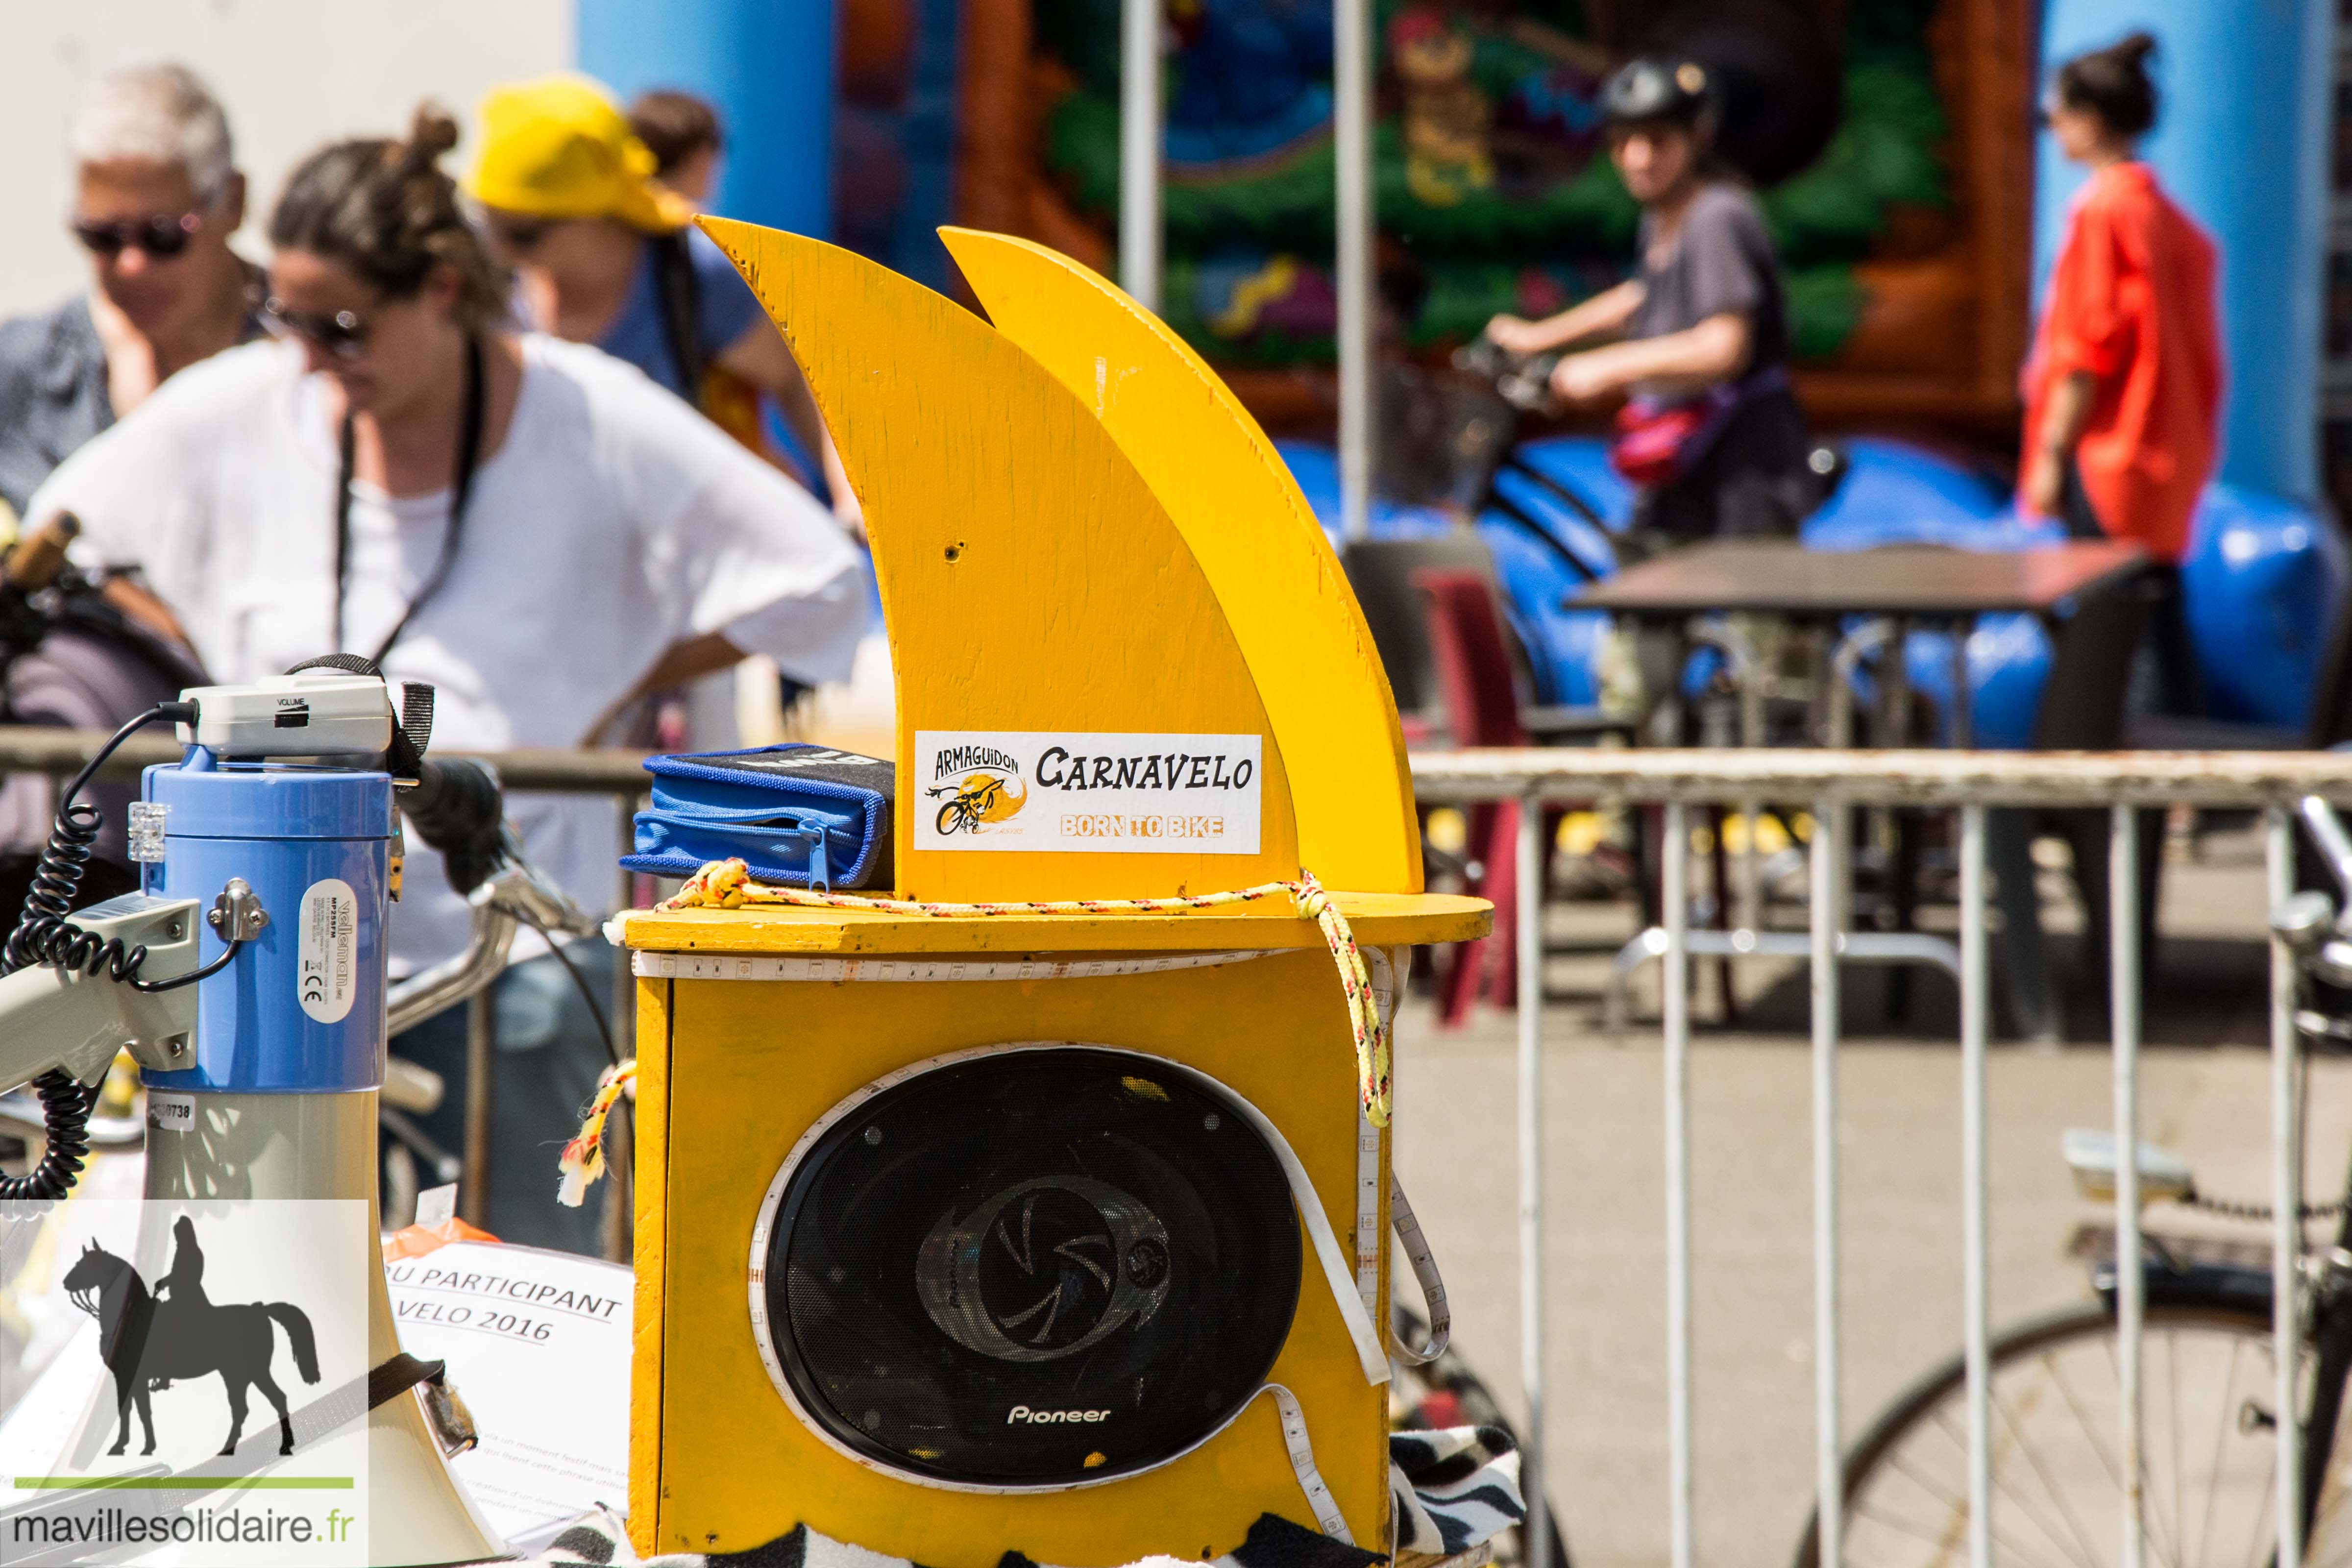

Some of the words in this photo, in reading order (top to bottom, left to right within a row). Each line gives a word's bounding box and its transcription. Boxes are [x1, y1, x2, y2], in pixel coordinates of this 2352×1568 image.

[277, 698, 305, 706] VOLUME
[1036, 746, 1252, 791] CARNAVELO
[1060, 814, 1126, 837] BORN
[1130, 815, 1163, 837] TO
[1167, 816, 1224, 838] BIKE
[420, 1269, 623, 1318] PARTICIPANT
[397, 1300, 472, 1324] VELO
[477, 1312, 554, 1341] 2016
[1007, 1405, 1111, 1424] Pioneer
[516, 1442, 560, 1458] moment
[562, 1453, 589, 1467] festif
[558, 1468, 594, 1483] phrase
